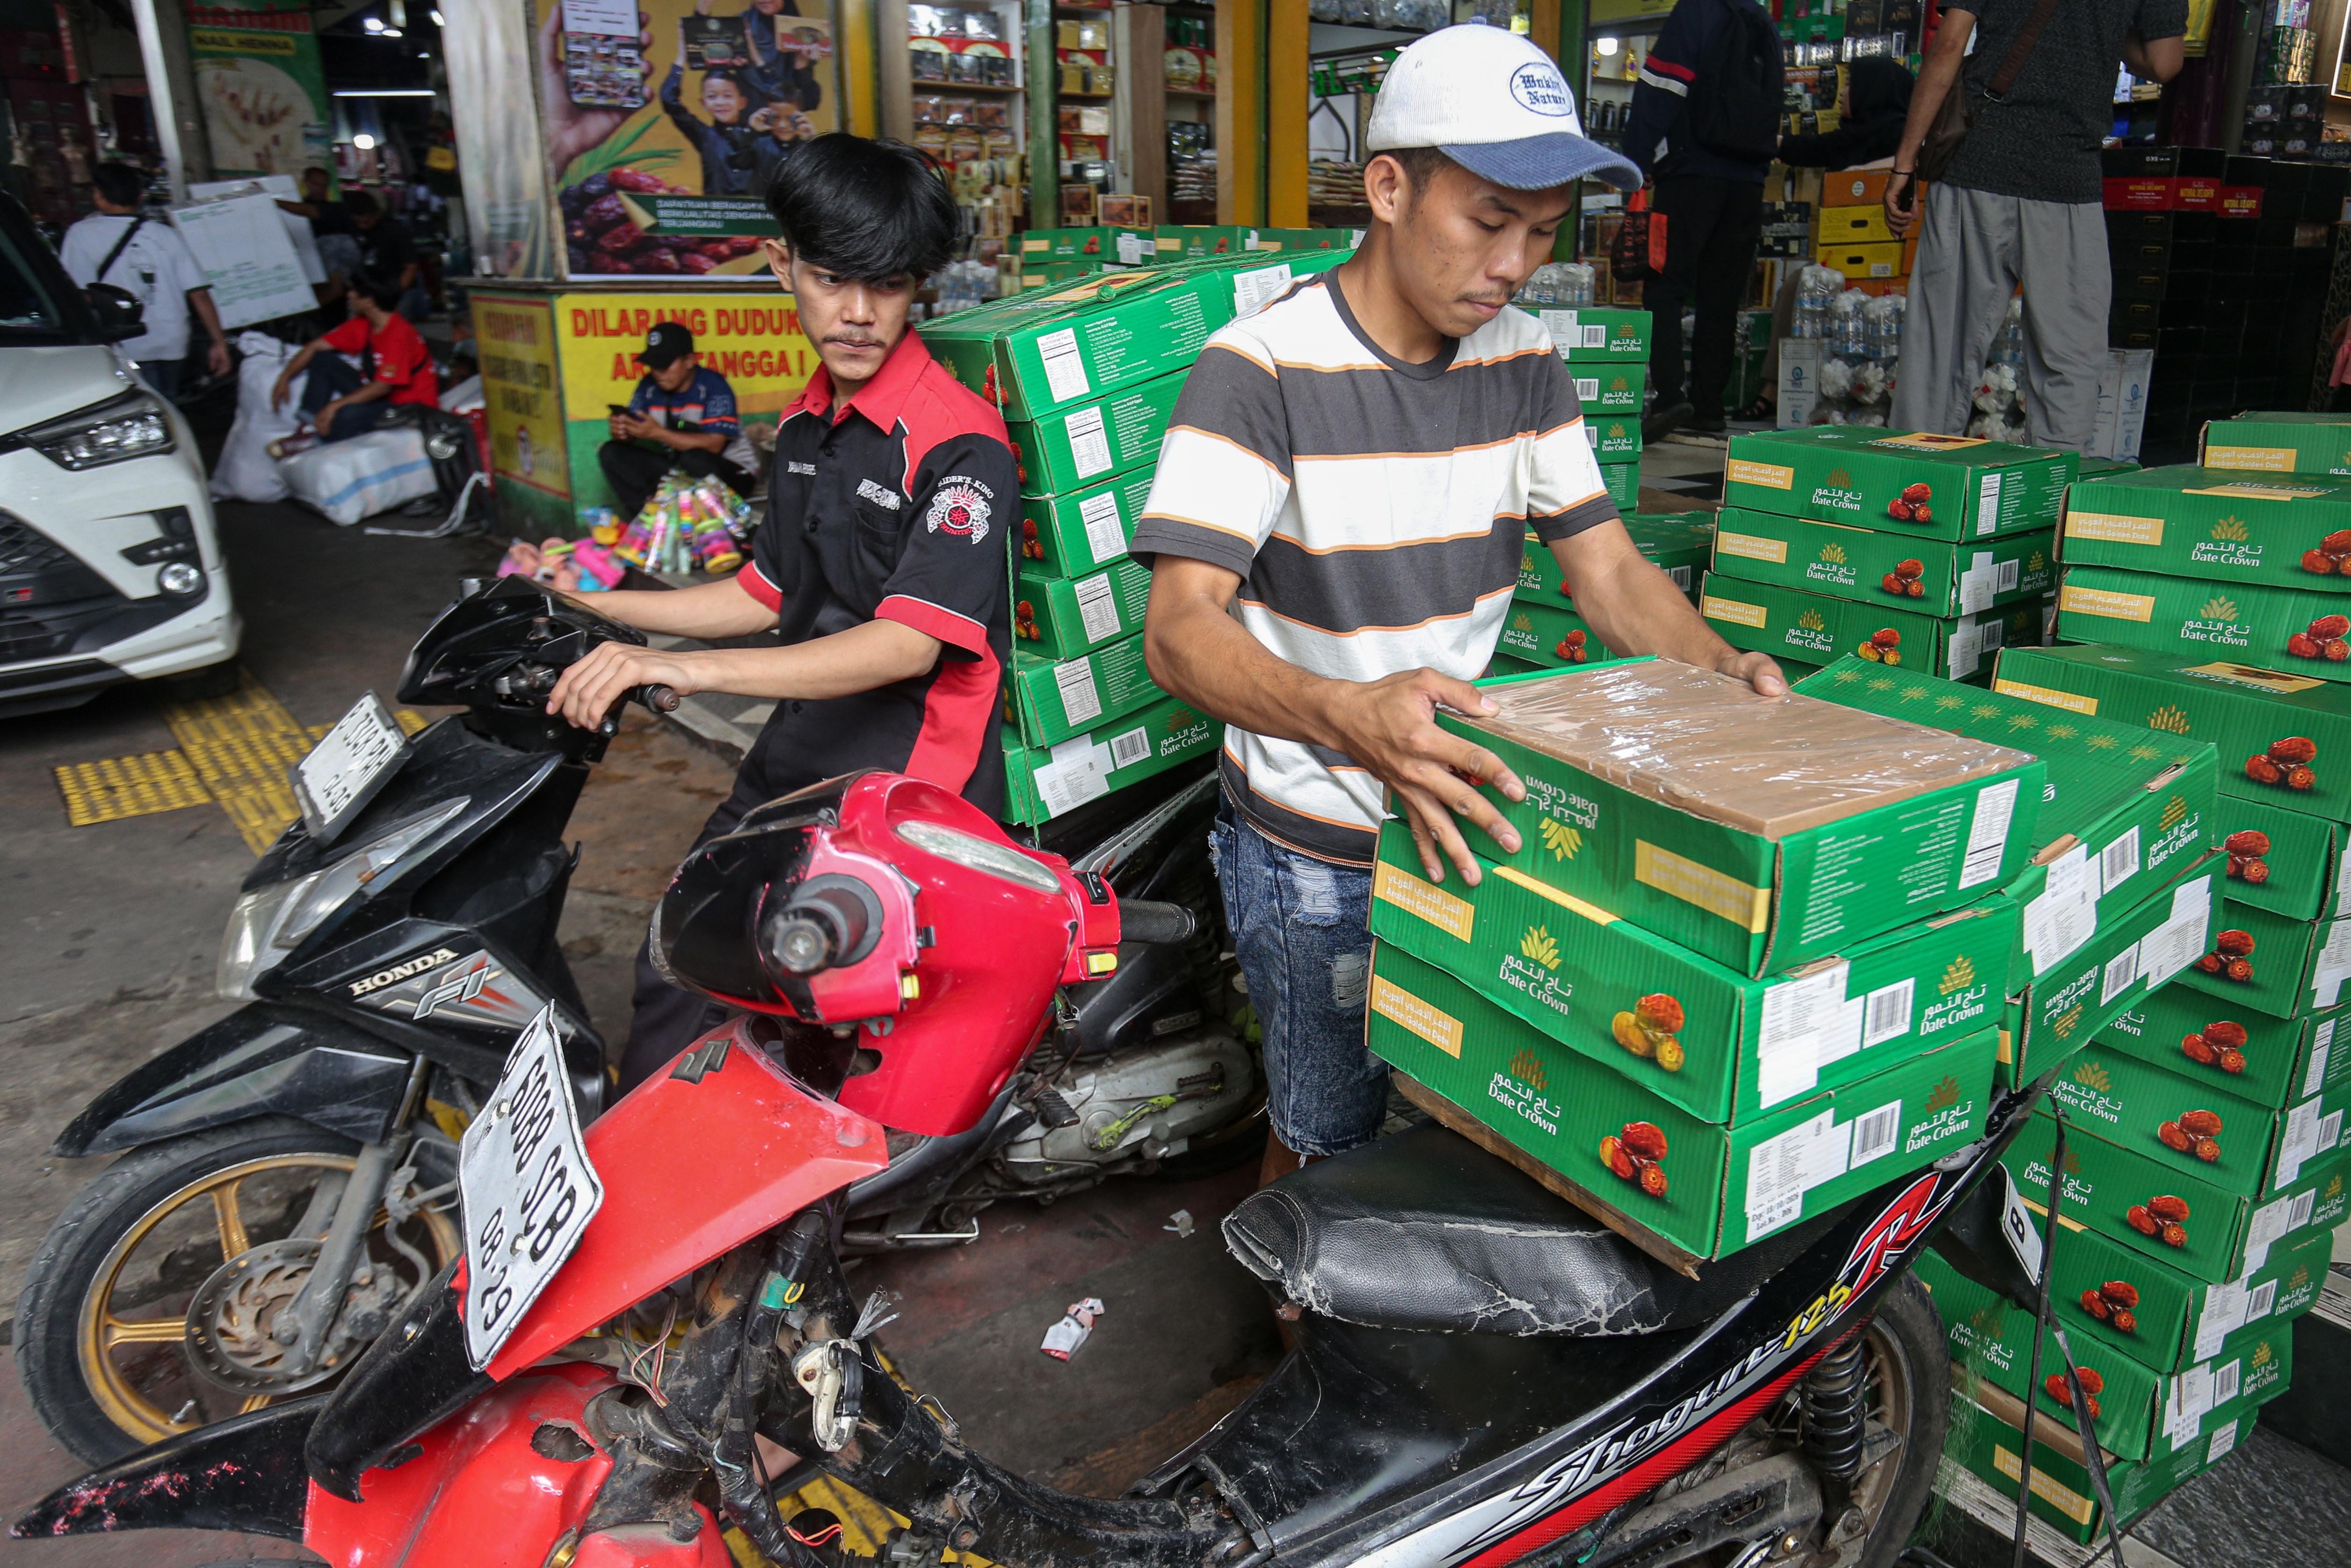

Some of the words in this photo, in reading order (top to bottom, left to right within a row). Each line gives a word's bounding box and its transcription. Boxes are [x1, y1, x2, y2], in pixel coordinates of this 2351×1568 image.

[571, 309, 706, 336] DILARANG
[715, 309, 803, 336] DUDUK
[2209, 459, 2236, 467] Arabian
[1812, 495, 1831, 506] Date
[1832, 497, 1860, 511] Crown
[2077, 527, 2104, 536] Arabian
[2106, 529, 2131, 538] Golden
[2133, 531, 2149, 540] Date
[2191, 550, 2218, 563] Date
[2220, 552, 2260, 567] Crown
[1520, 579, 1540, 590] Crown
[1807, 570, 1826, 581] Date
[1827, 573, 1855, 586] Crown
[2021, 583, 2032, 592] Date
[2032, 580, 2047, 589] Crown
[2068, 602, 2095, 611] Arabian
[2096, 604, 2120, 614] Golden
[1503, 635, 1517, 645] Date
[1518, 639, 1537, 650] Crown
[1785, 635, 1804, 646] Date
[1805, 638, 1831, 652] Crown
[2180, 628, 2207, 641] Date
[2210, 632, 2248, 647] Crown
[338, 702, 364, 730] B
[1160, 744, 1180, 757] Date
[1181, 731, 1209, 747] Crown
[1525, 775, 1567, 804] Crown
[1568, 793, 1599, 818] Date
[2148, 851, 2168, 871] Date
[2169, 829, 2199, 854] Crown
[1386, 886, 1415, 907] Arabian
[1416, 900, 1440, 920] Golden
[1442, 914, 1460, 930] Date
[348, 947, 460, 997] HONDA
[2077, 965, 2099, 982] Date
[413, 964, 491, 1021] FI
[1499, 965, 1527, 992] Date
[1528, 982, 1569, 1016] Crown
[2046, 983, 2076, 1009] Crown
[1378, 1000, 1405, 1020] Arabian
[1406, 1015, 1431, 1036] Golden
[1431, 1029, 1450, 1046] Date
[1920, 1013, 1946, 1036] Date
[1948, 1002, 1984, 1025] Crown
[501, 1021, 539, 1083] B
[510, 1053, 554, 1176] 6088
[1488, 1082, 1516, 1110] Date
[1517, 1101, 1557, 1136] Crown
[2053, 1087, 2079, 1105] Date
[2081, 1099, 2119, 1123] Crown
[1906, 1130, 1930, 1154] Date
[1933, 1119, 1969, 1141] Crown
[2024, 1168, 2049, 1187] Date
[521, 1144, 578, 1263] SCB
[2311, 1215, 2325, 1227] Date
[2326, 1206, 2343, 1220] Crown
[2010, 1207, 2025, 1244] B
[2275, 1302, 2289, 1316] Date
[2289, 1293, 2310, 1311] Crown
[2243, 1381, 2257, 1397] Date
[2257, 1371, 2279, 1390] Crown
[1473, 1338, 1786, 1542] Shogun
[1780, 1279, 1852, 1354] 125
